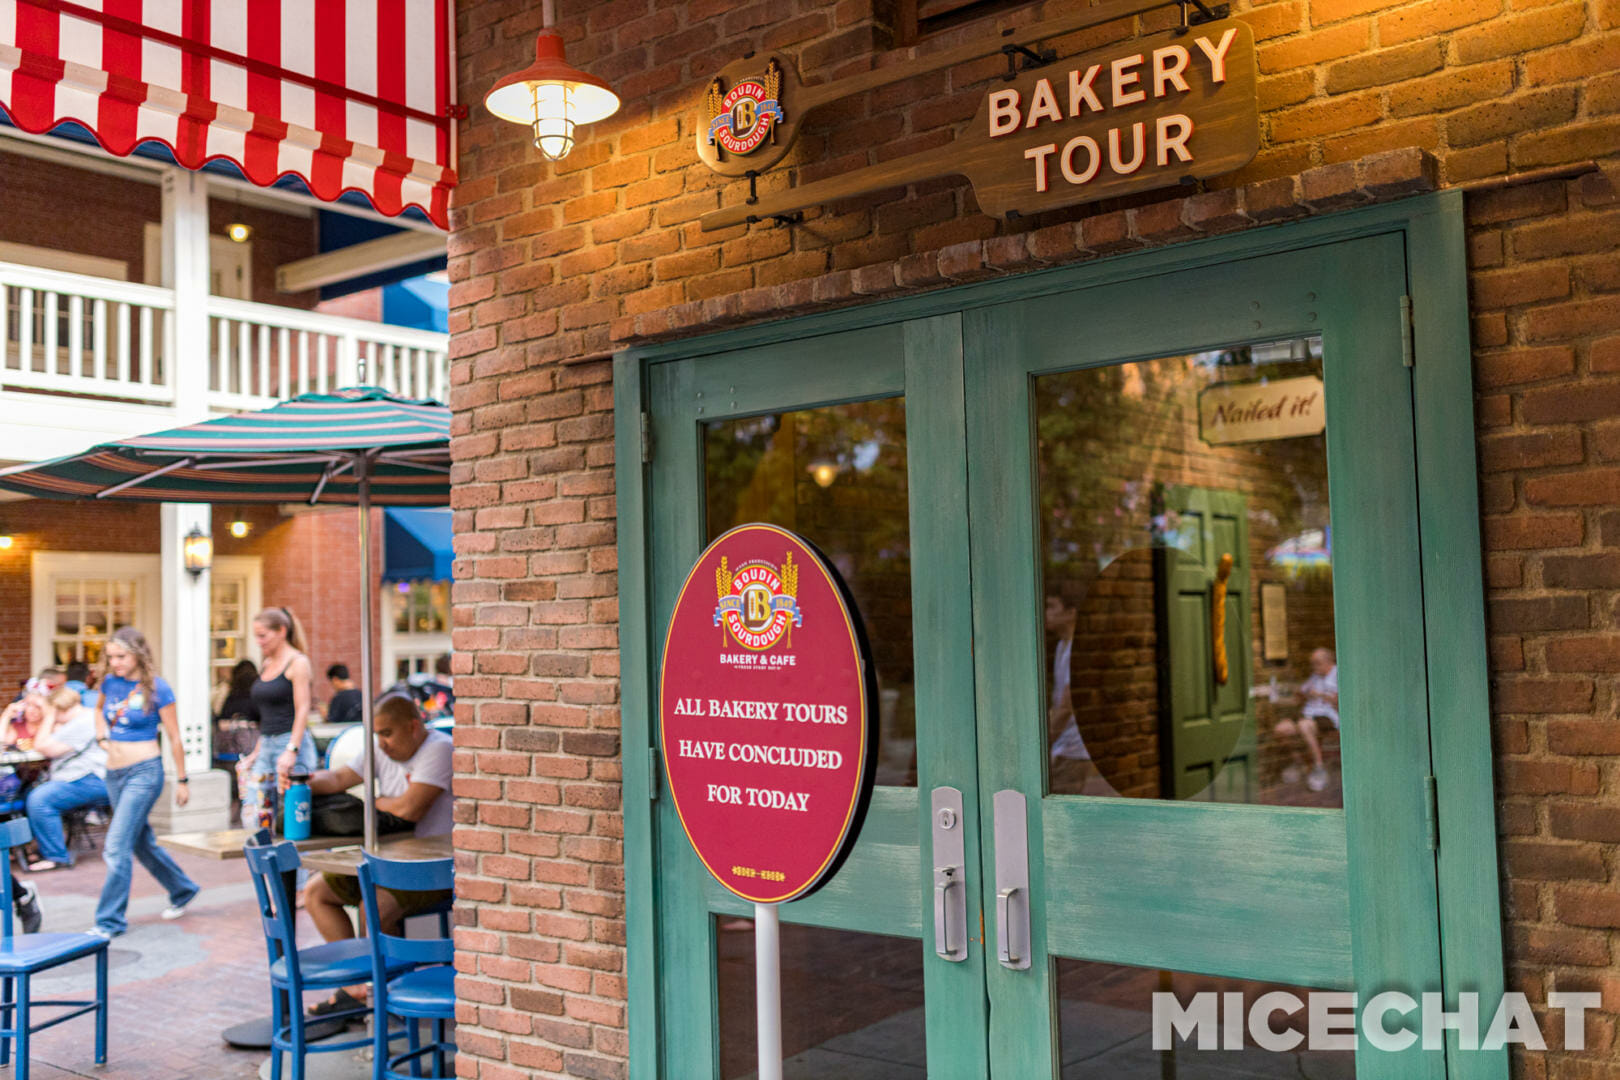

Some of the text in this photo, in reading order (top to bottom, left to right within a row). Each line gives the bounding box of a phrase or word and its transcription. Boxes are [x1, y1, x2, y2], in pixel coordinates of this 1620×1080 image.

[724, 84, 764, 108] BOUDIN
[989, 28, 1239, 138] BAKERY
[719, 117, 769, 151] SOURDOUGH
[1024, 114, 1194, 193] TOUR
[1211, 391, 1318, 426] Nailed it!
[734, 568, 780, 590] BOUDIN
[719, 598, 740, 610] SINCE
[775, 598, 794, 609] 1849
[728, 614, 787, 647] SOURDOUGH
[719, 653, 796, 666] BAKERY & CAFE
[674, 698, 848, 725] ALL BAKERY TOURS
[678, 739, 843, 770] HAVE CONCLUDED
[707, 784, 810, 812] FOR TODAY
